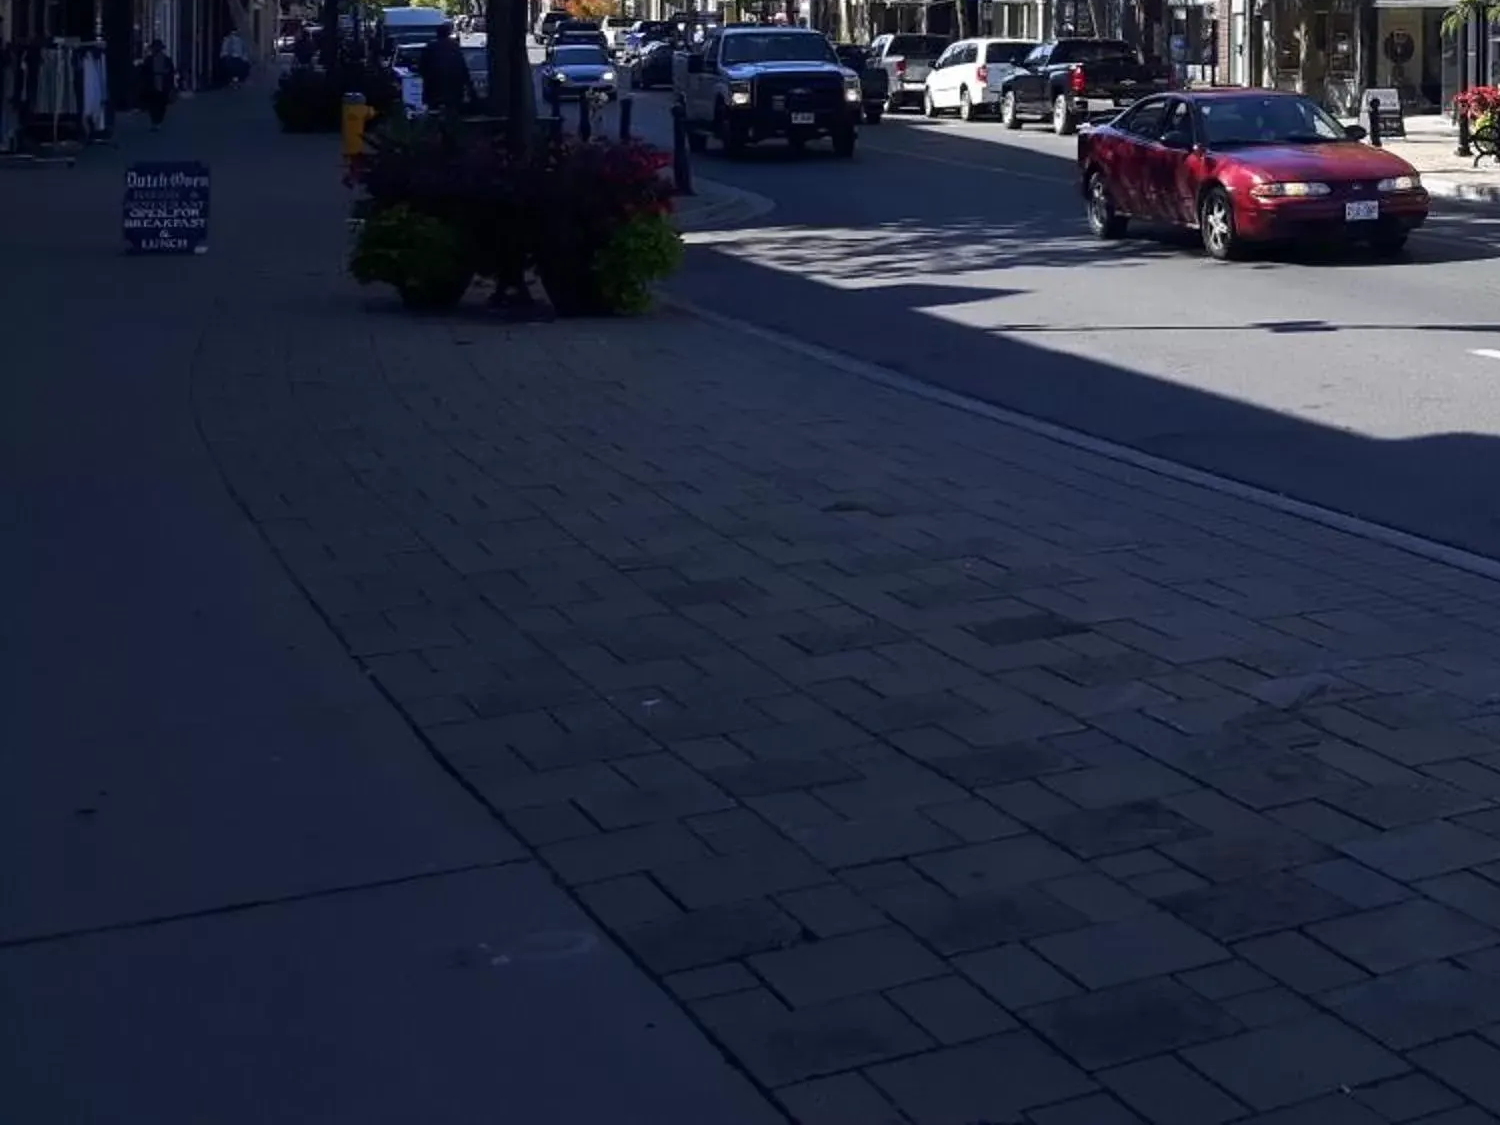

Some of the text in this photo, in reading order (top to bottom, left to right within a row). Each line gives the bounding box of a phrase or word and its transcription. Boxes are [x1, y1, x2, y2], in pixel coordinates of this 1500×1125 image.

[126, 170, 167, 187] Dutch
[129, 208, 199, 218] OPEN FOR
[124, 218, 205, 228] BREAKFAST
[141, 238, 188, 249] LUNCH
